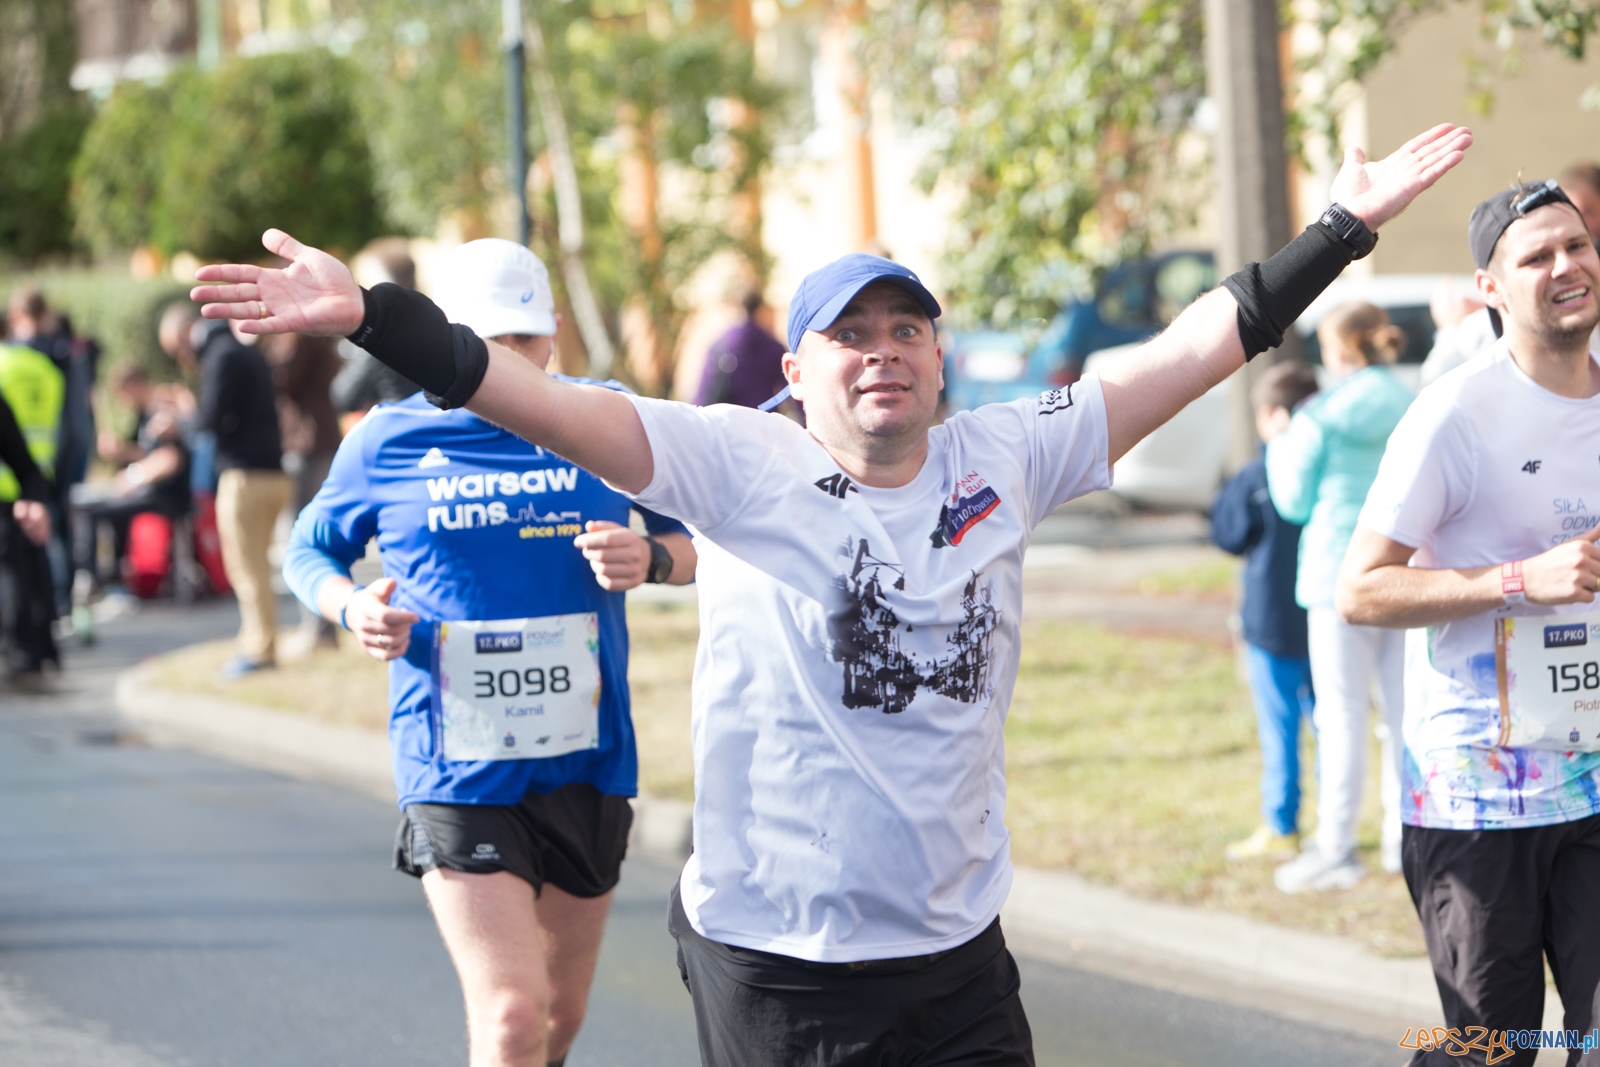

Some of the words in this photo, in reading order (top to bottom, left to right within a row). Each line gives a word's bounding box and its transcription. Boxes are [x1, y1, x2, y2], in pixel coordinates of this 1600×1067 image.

[1521, 460, 1542, 474] 4F
[426, 467, 578, 501] warsaw
[966, 478, 987, 495] Run
[1553, 498, 1587, 515] SIŁA
[427, 501, 509, 532] runs
[519, 525, 555, 539] since
[495, 635, 520, 649] PKO
[1548, 631, 1563, 643] 17.
[1563, 629, 1585, 642] PKO
[474, 665, 571, 698] 3098
[1547, 661, 1600, 693] 158
[505, 704, 545, 718] Kamil
